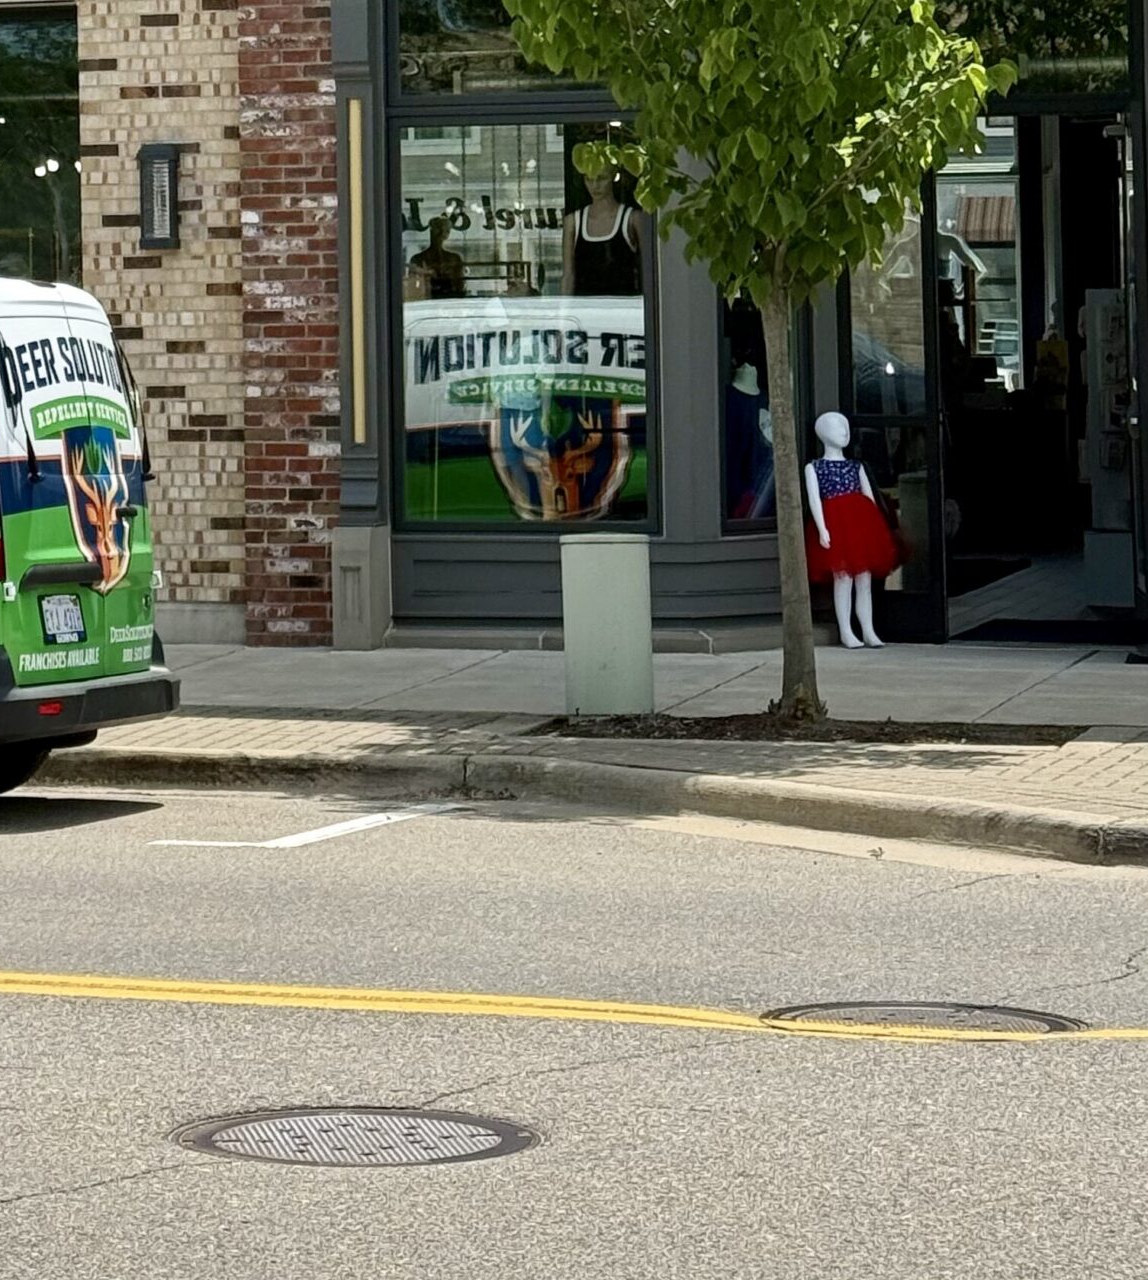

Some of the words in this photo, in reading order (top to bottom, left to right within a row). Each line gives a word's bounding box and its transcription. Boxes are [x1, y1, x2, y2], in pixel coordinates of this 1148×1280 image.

[36, 401, 95, 429] REPELLENT
[96, 402, 128, 428] SERVICE
[19, 651, 67, 672] FRANCHISES
[67, 646, 100, 668] AVAILABLE
